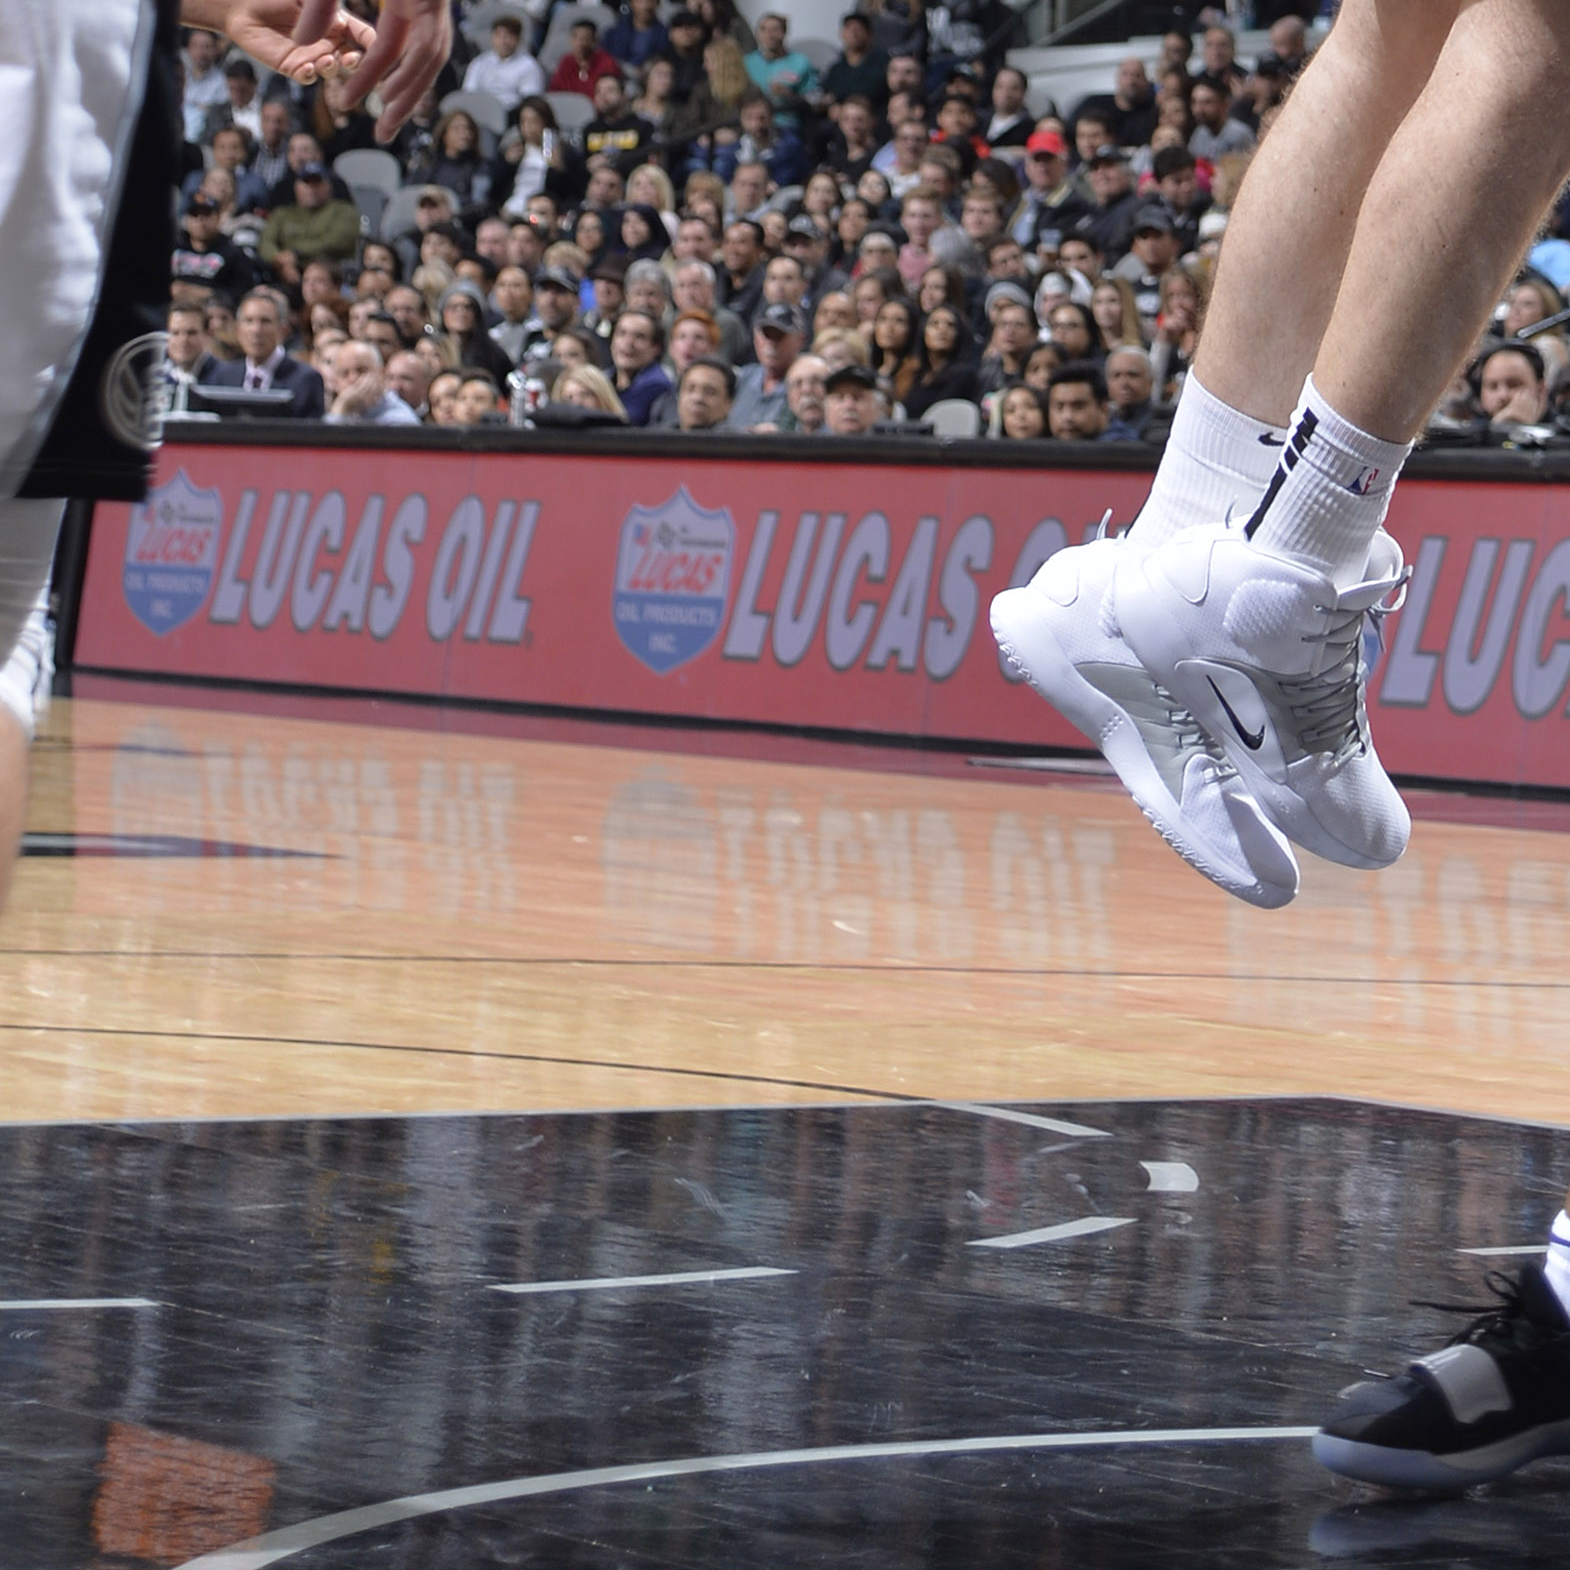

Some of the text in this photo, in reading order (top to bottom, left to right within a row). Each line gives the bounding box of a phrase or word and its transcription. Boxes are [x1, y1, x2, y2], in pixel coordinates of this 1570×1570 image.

[208, 488, 542, 645] LUCAS OIL
[628, 549, 724, 594] LUCAS
[645, 604, 716, 627] PRODUCTS
[721, 509, 995, 683] LUCAS
